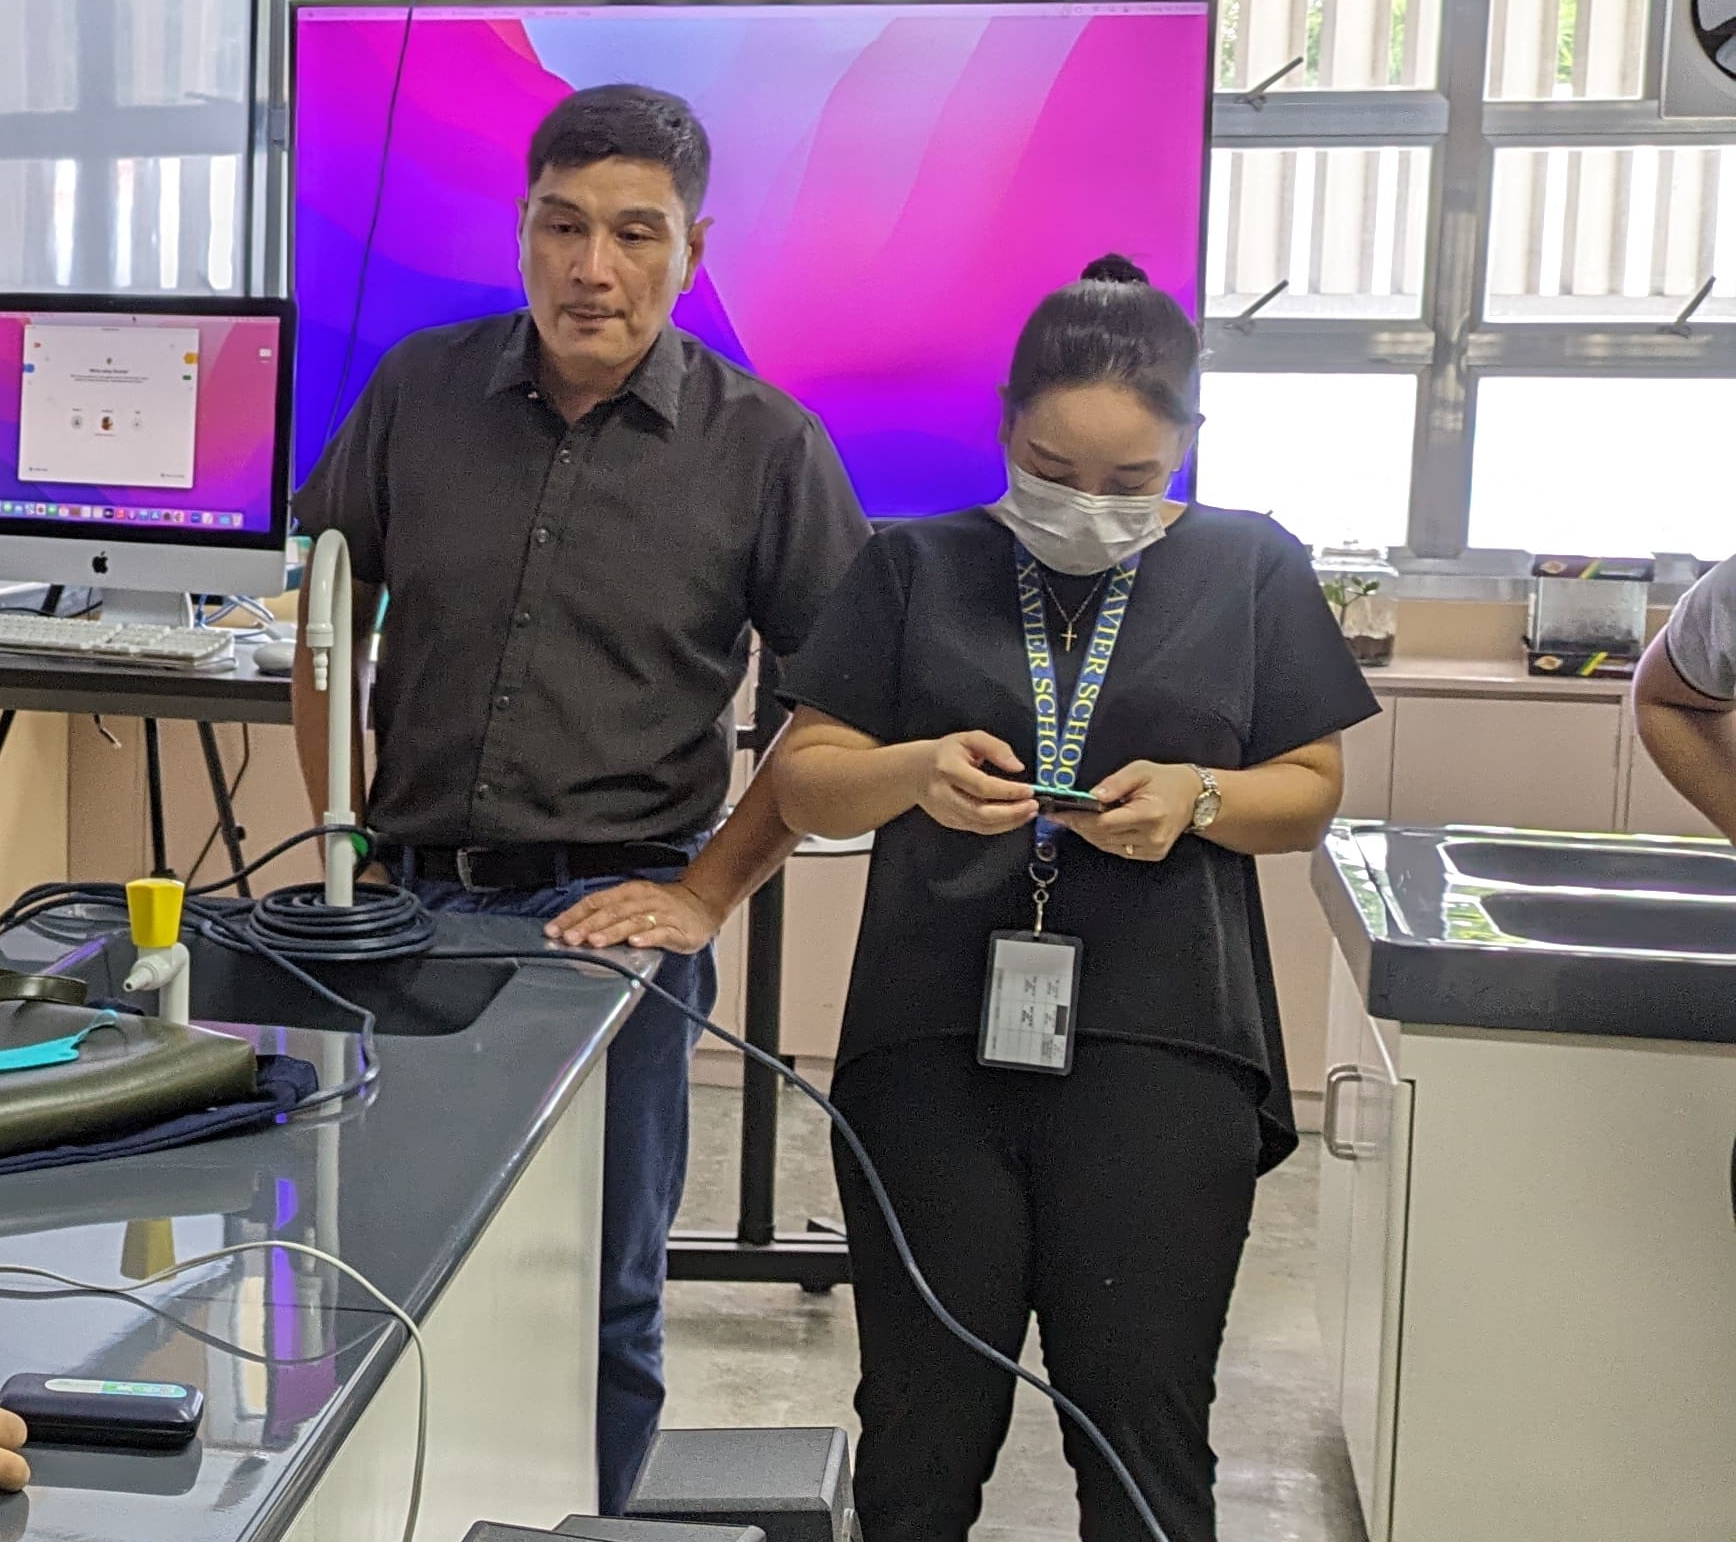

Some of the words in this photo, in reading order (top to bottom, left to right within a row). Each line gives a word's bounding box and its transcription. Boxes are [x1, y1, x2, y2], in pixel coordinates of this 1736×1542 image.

[1017, 560, 1049, 669] XAVIER
[1084, 563, 1136, 674] XAVIER
[1032, 677, 1057, 787] SCHOO
[1053, 682, 1099, 789] SCHOO
